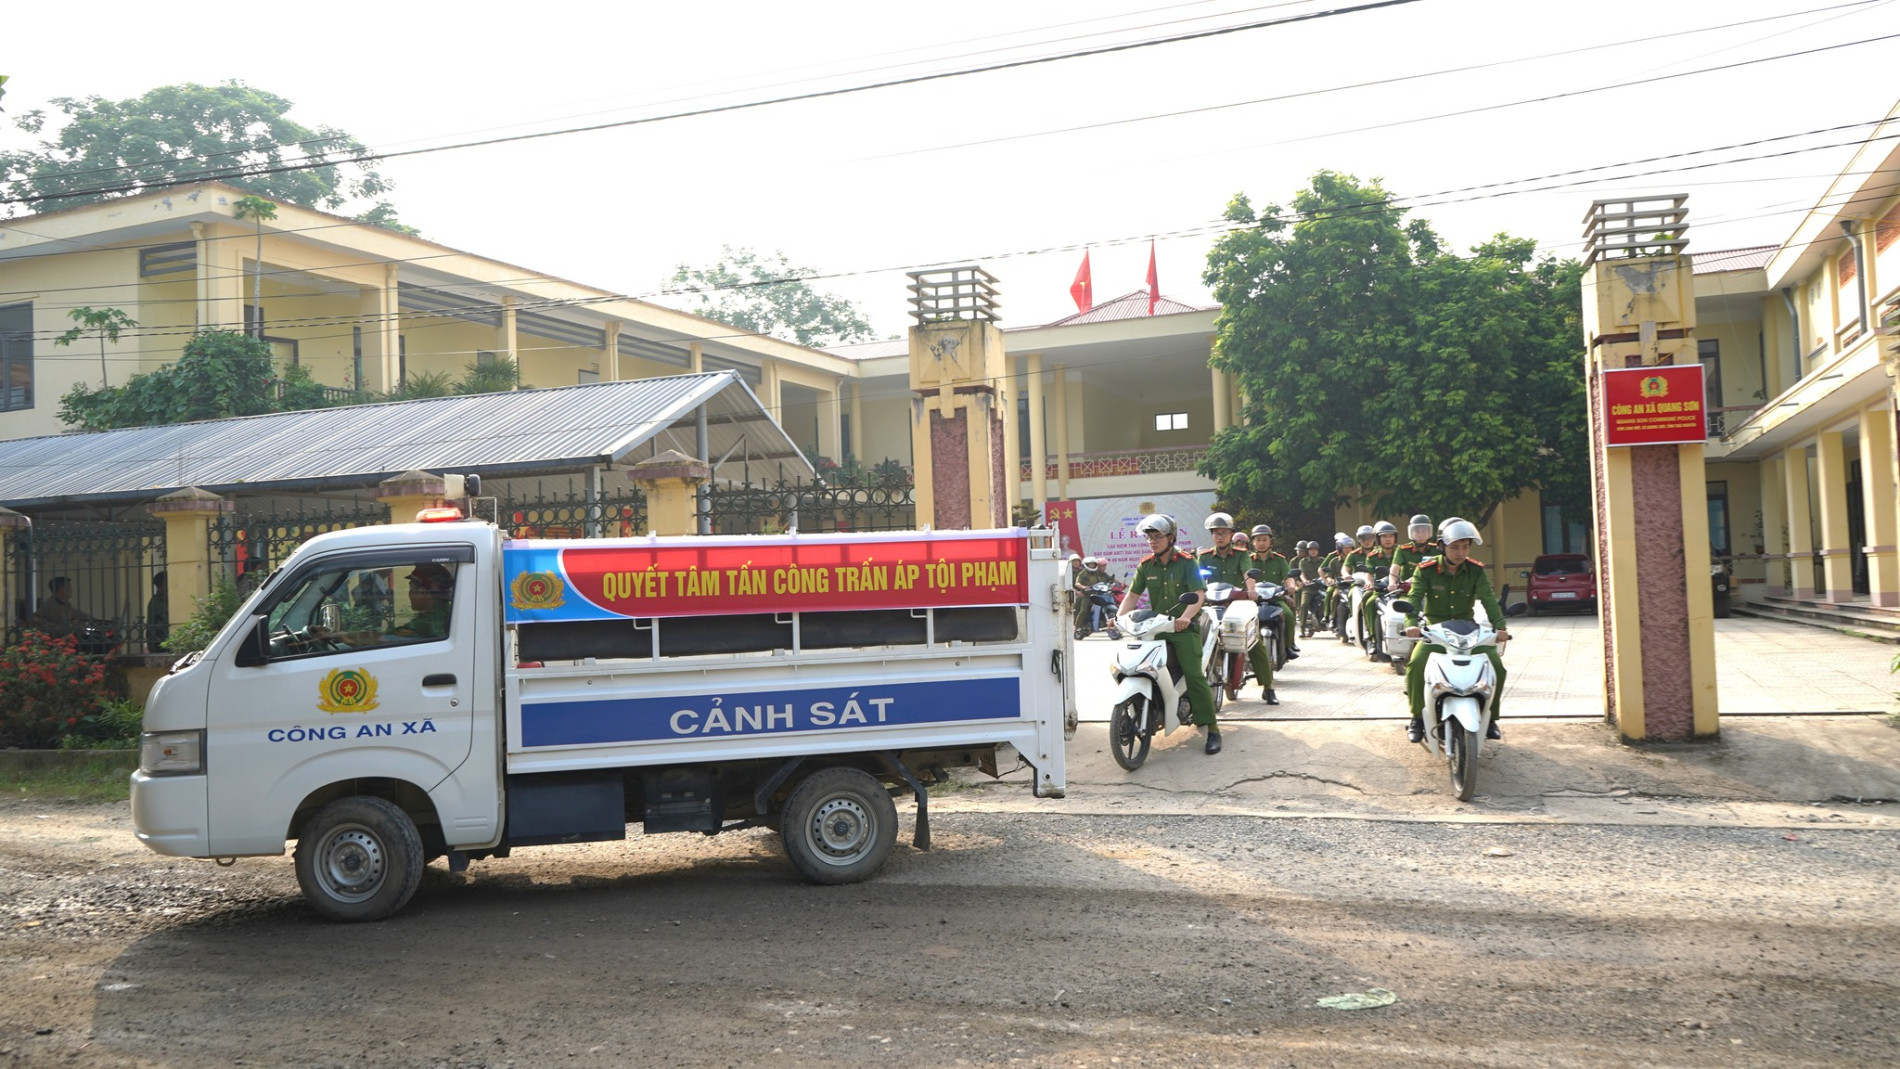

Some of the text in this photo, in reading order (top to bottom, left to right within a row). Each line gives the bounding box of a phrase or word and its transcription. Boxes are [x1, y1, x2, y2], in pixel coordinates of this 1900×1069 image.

[1612, 401, 1699, 415] CÔNG AN XÃ QUANG SƠN
[602, 556, 1017, 602] QUYẾT TÂM TẤN CÔNG TRẤN ÁP TỘI PHẠM
[268, 717, 437, 743] CÔNG AN XÃ
[669, 691, 895, 735] CẢNH SÁT
